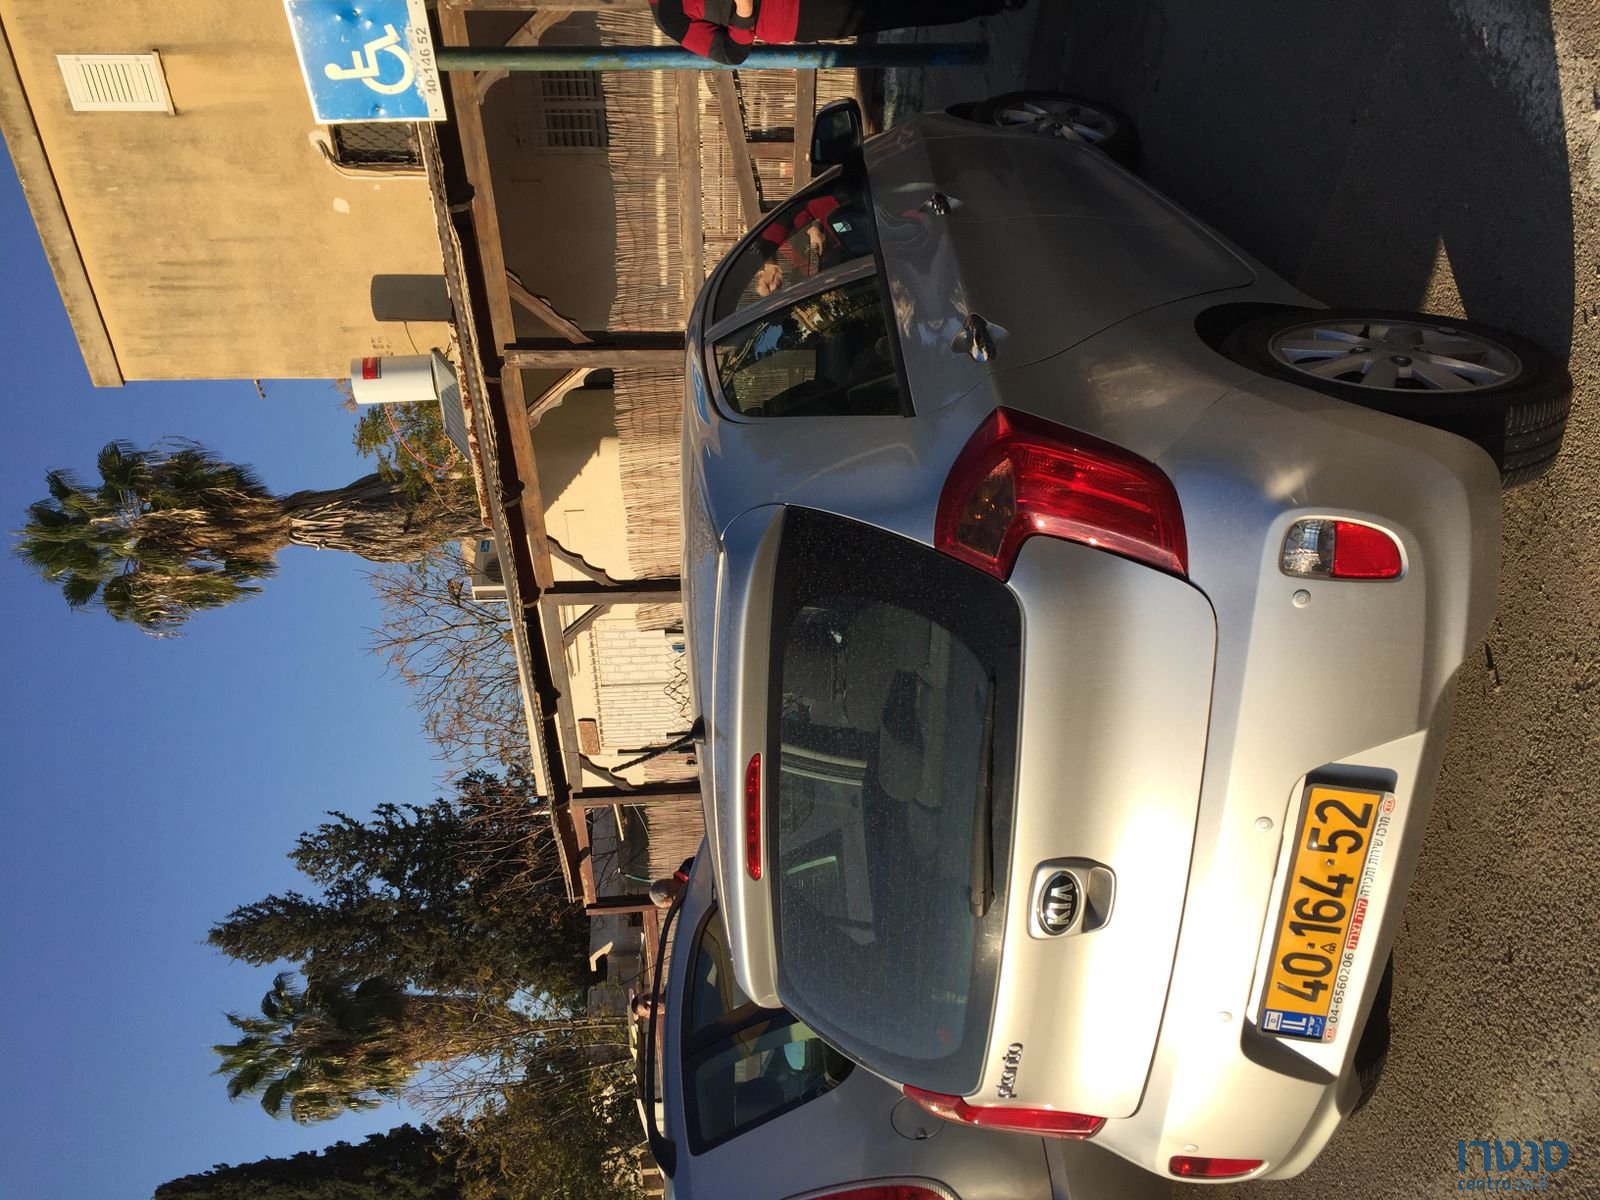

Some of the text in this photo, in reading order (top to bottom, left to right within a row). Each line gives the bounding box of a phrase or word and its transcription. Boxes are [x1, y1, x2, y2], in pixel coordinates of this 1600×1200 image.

[415, 27, 428, 44] 52
[1360, 816, 1390, 897] מרכז שירות ומכירה
[1047, 883, 1073, 926] KIA
[1347, 899, 1367, 949] קיה נצרת
[1328, 952, 1355, 1023] 04-6560206
[1281, 1017, 1307, 1031] IL
